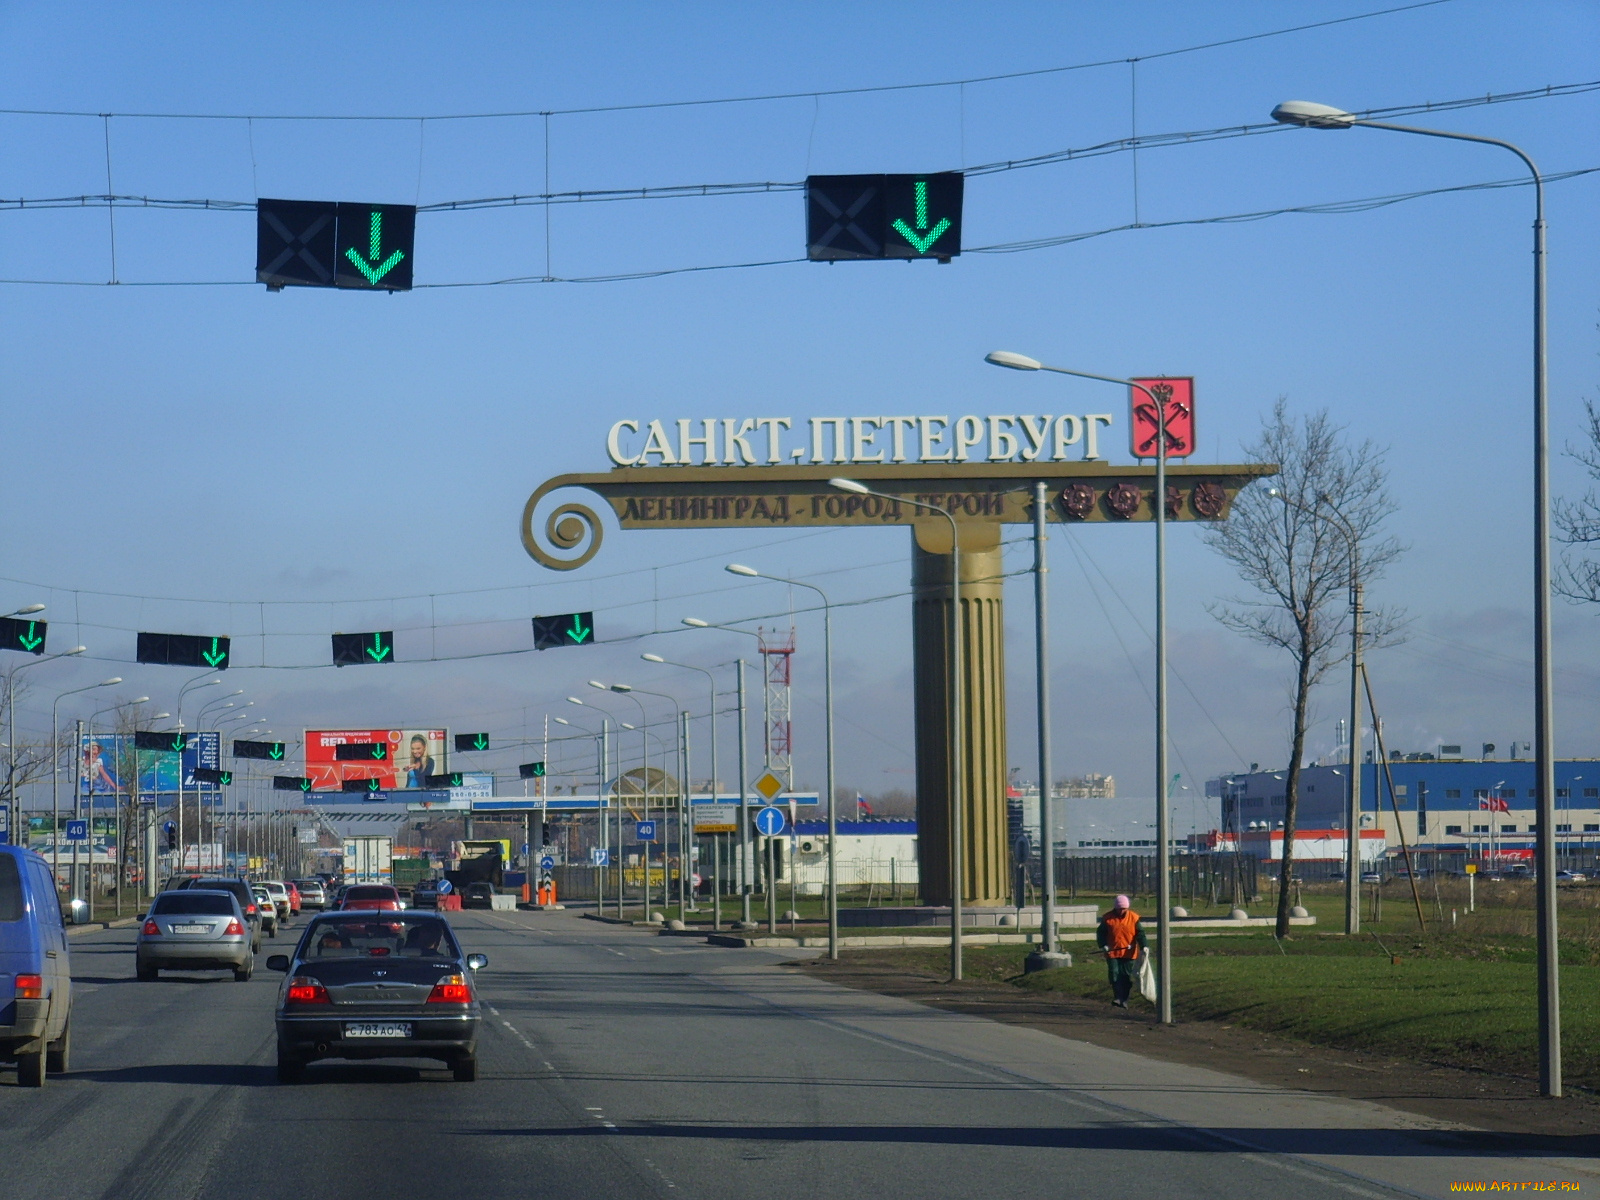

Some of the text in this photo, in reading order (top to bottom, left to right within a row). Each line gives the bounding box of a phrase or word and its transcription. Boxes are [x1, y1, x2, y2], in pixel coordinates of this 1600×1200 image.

[607, 414, 1112, 466] САНКТ-ПЕТЕРБУРГ
[621, 495, 790, 523] ЛЕНИНГРАД
[811, 493, 903, 521] ГОРОД
[914, 484, 1004, 517] ГЕРОЙ
[320, 738, 347, 747] RED
[70, 826, 83, 835] 40
[640, 826, 652, 834] 40
[79, 837, 105, 846] ЕВО-4
